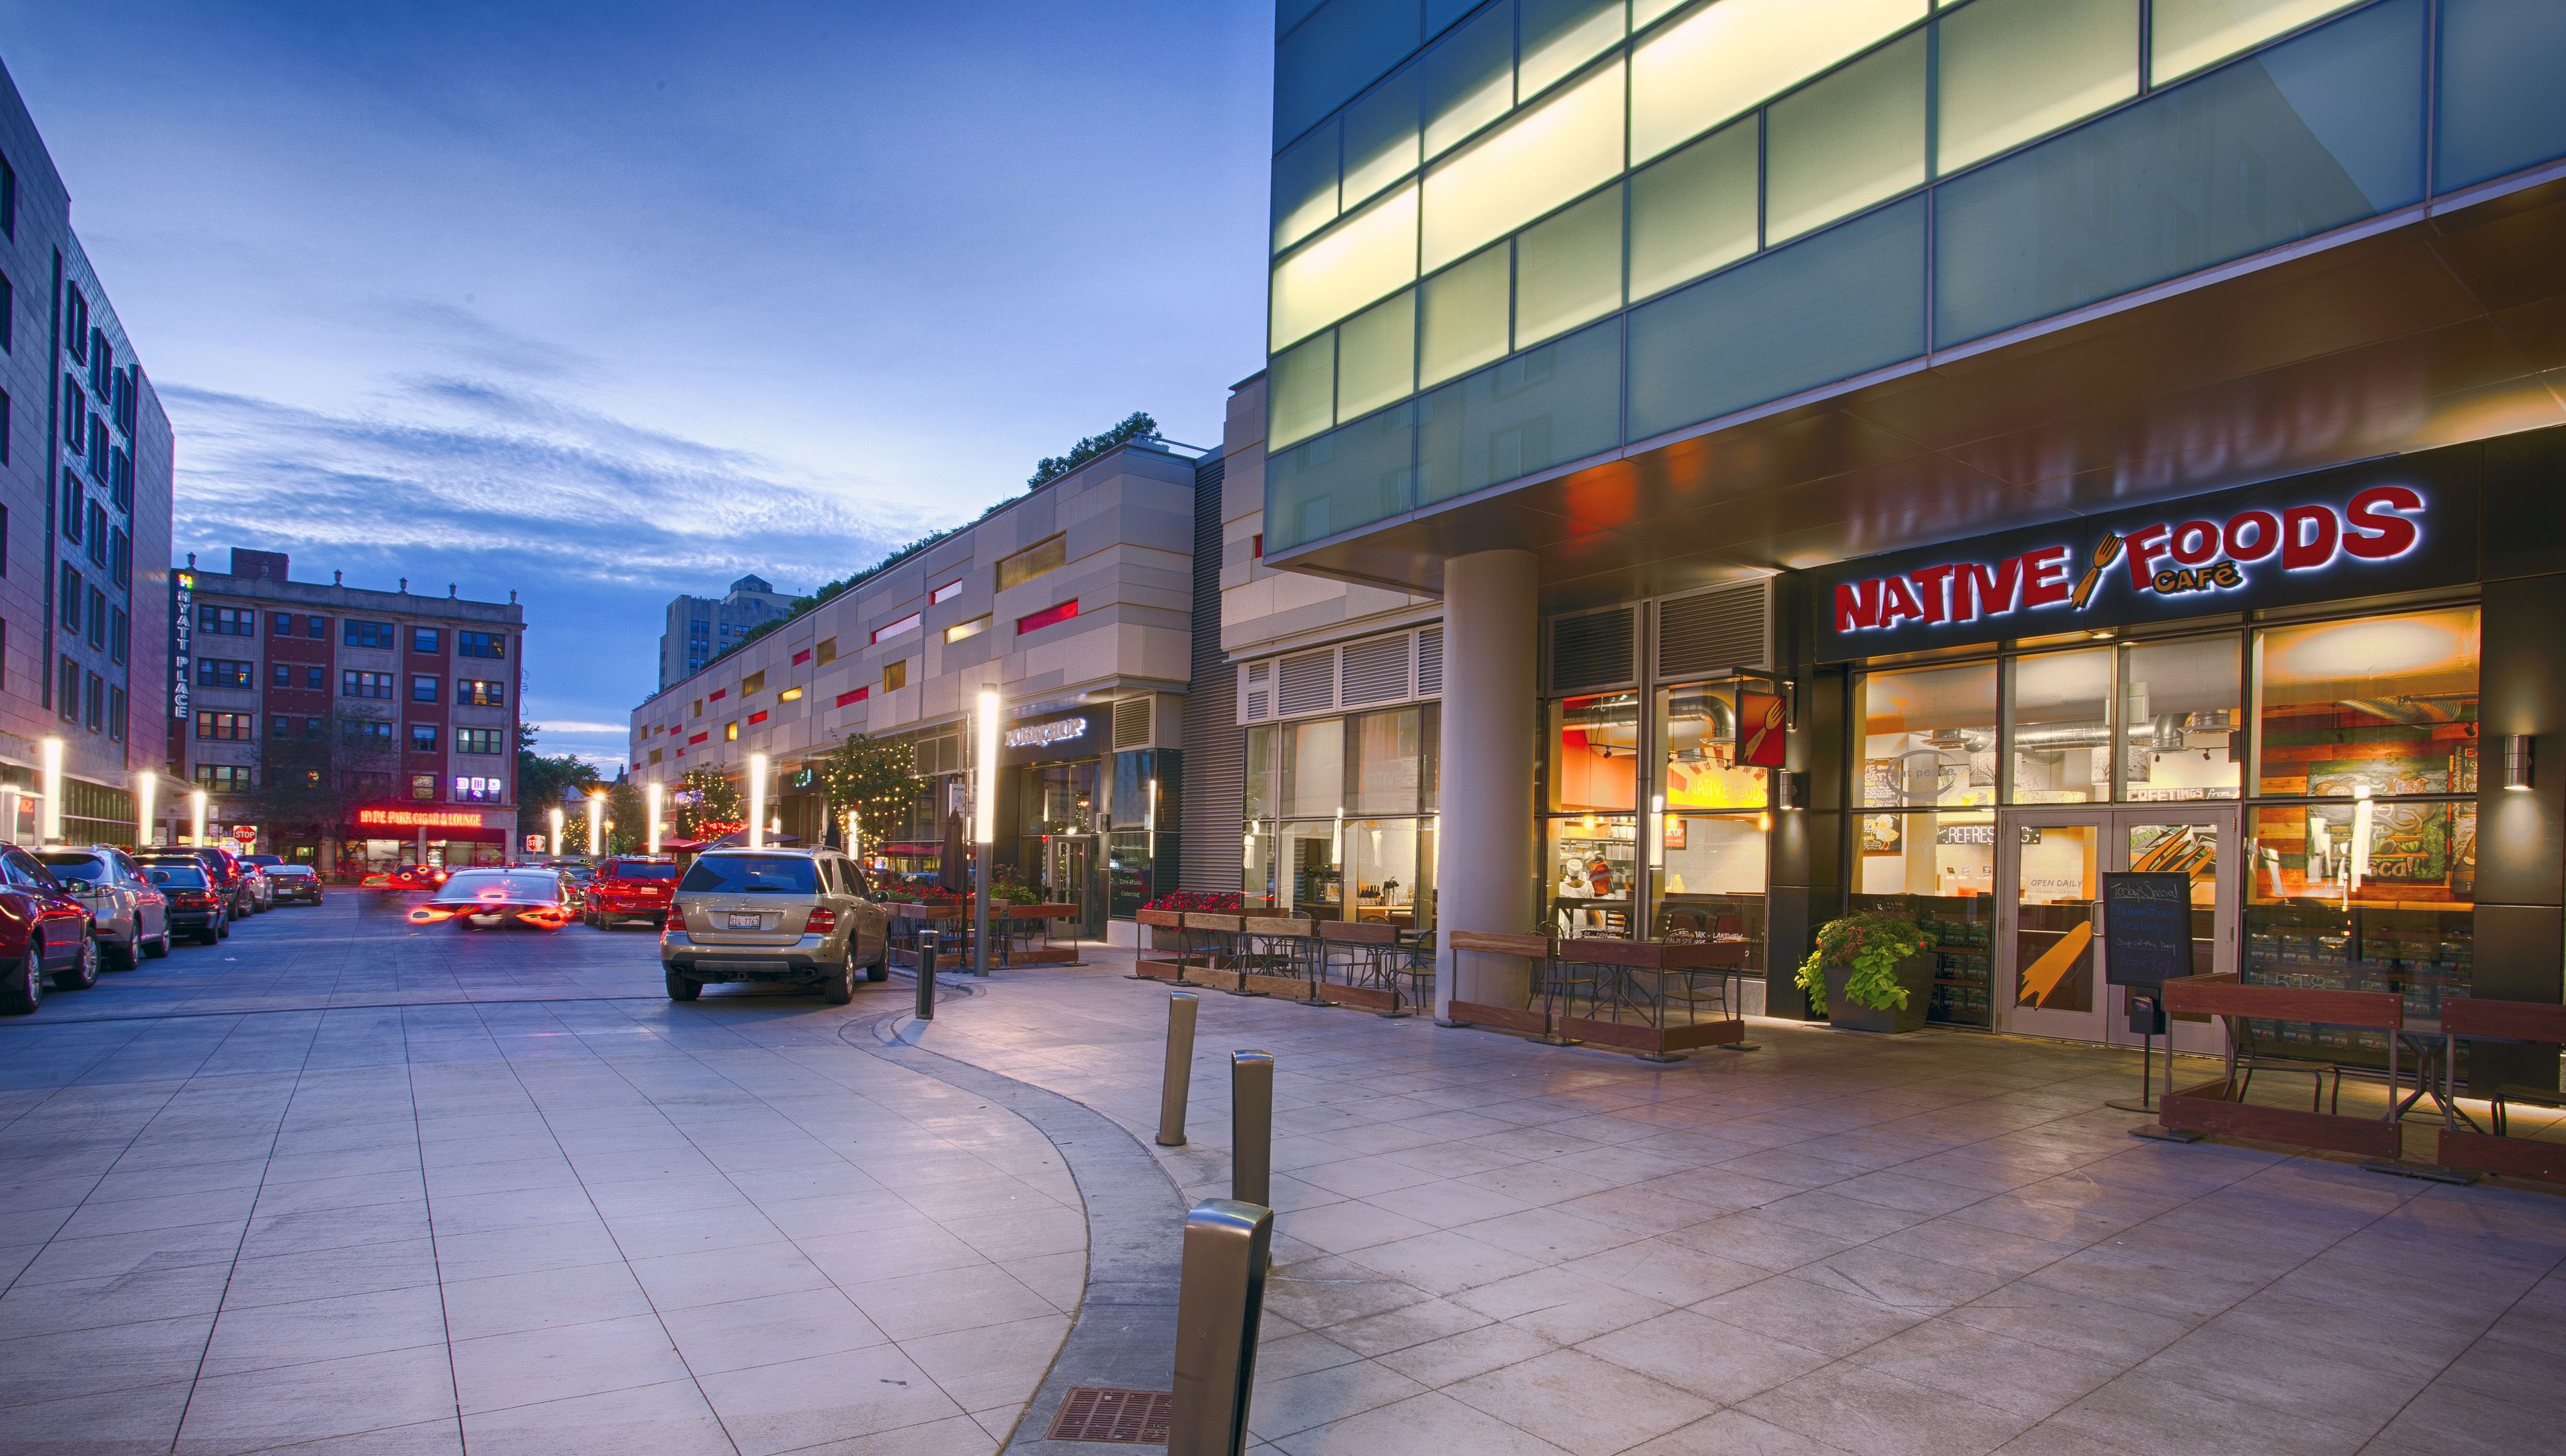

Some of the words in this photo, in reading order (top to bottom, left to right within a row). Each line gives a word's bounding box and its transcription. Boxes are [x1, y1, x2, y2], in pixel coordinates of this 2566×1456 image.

[1834, 546, 2072, 632] NATIVE
[2124, 486, 2424, 591] FOODS
[177, 590, 191, 651] HYATT
[175, 656, 190, 718] PLACE
[1005, 718, 1084, 746] PORKCHOP
[1686, 778, 1730, 800] NATIVE
[448, 814, 482, 826] LOUNGE
[235, 831, 255, 839] STOP
[1949, 826, 2030, 843] REFRESG
[2368, 856, 2414, 877] sca!
[2057, 880, 2083, 888] DAILY
[1121, 890, 1140, 898] Catering
[744, 918, 759, 926] 7763
